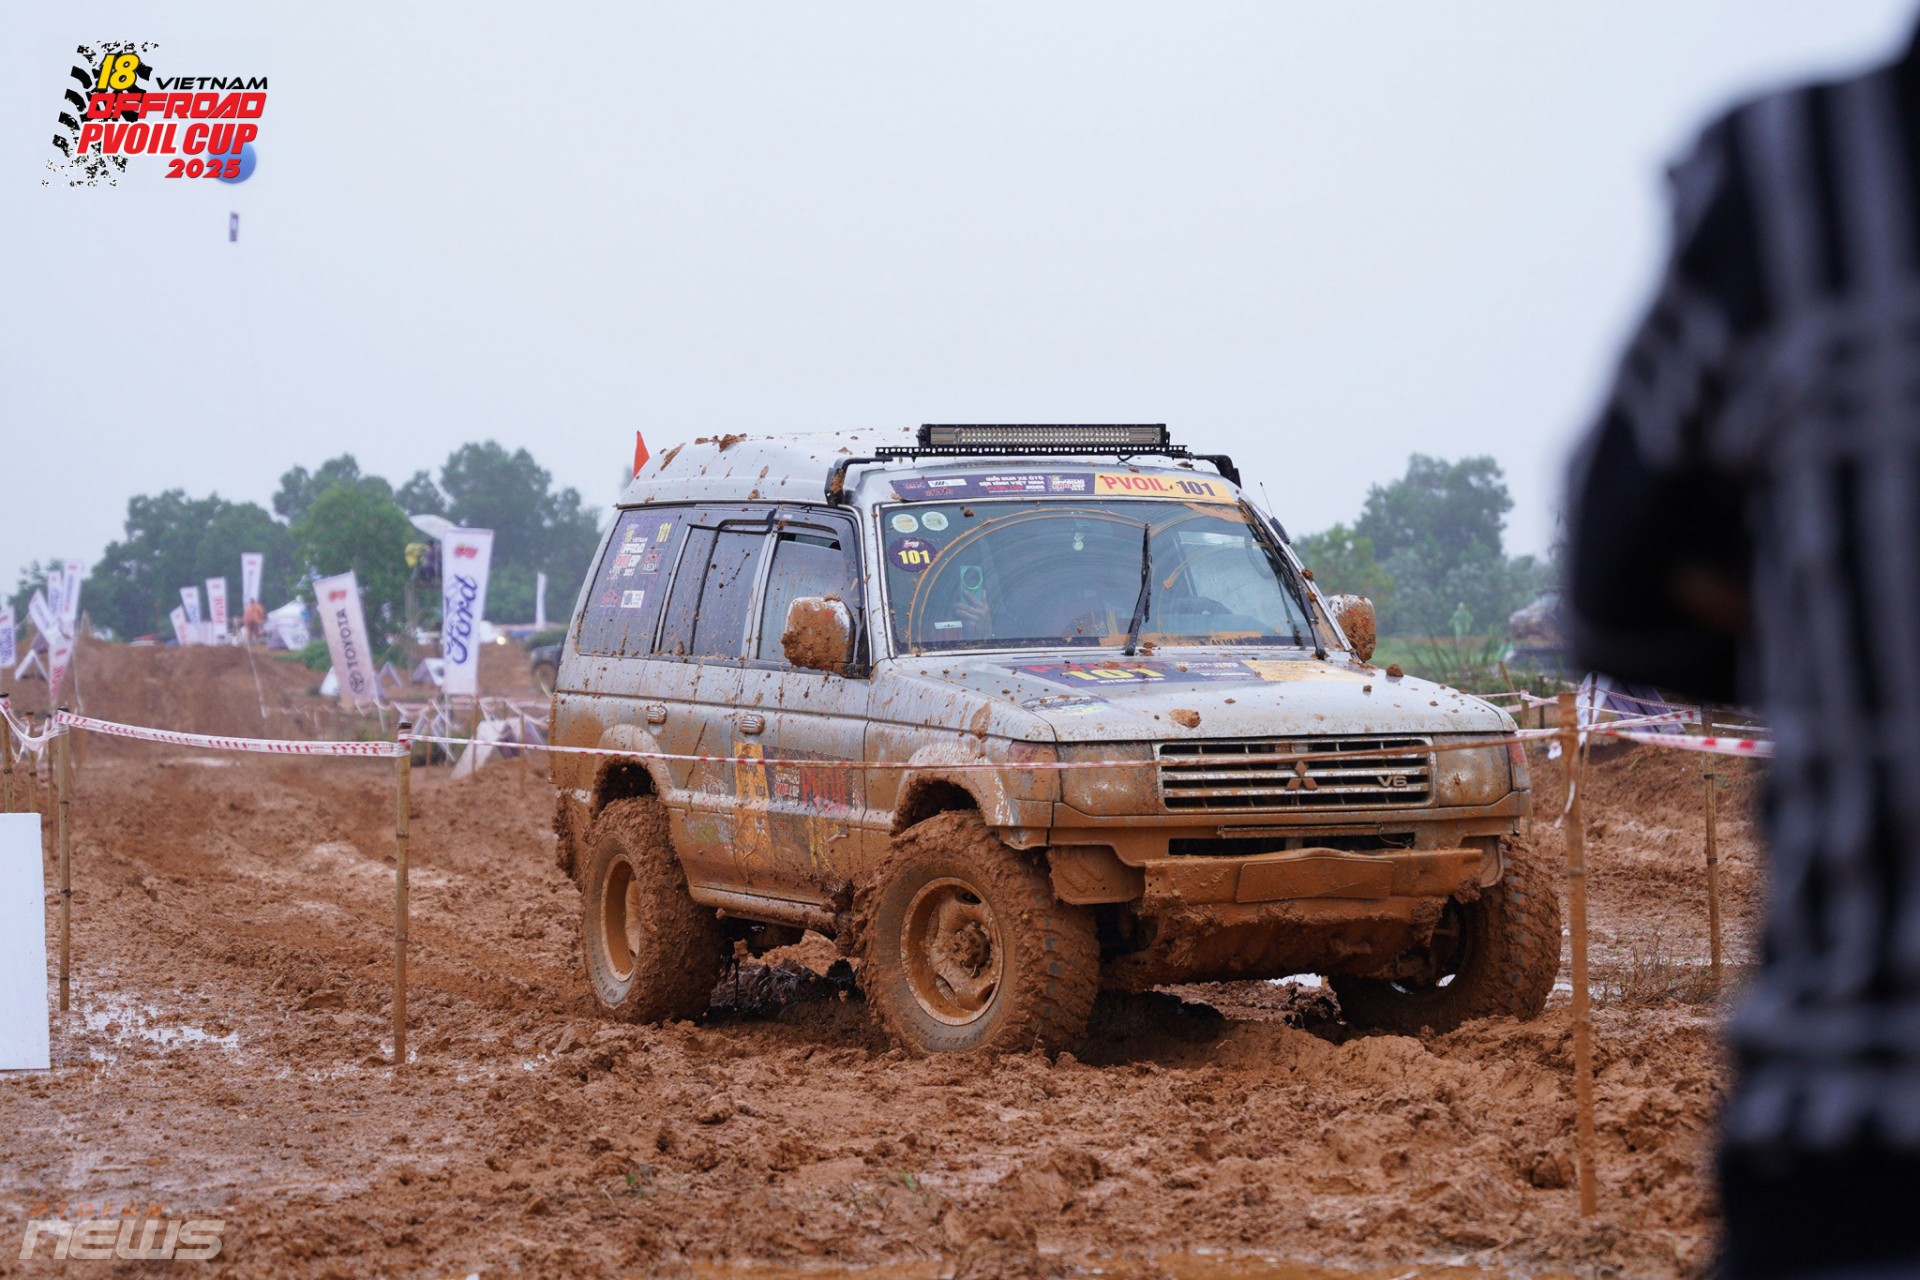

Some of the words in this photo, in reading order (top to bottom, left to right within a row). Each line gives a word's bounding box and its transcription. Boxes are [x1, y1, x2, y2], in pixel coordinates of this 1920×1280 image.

[1102, 476, 1169, 492] PVOIL
[1176, 480, 1216, 497] 101
[898, 550, 931, 565] 101
[445, 574, 478, 664] Ford
[336, 607, 359, 670] TOYOTA
[1377, 775, 1408, 788] V6
